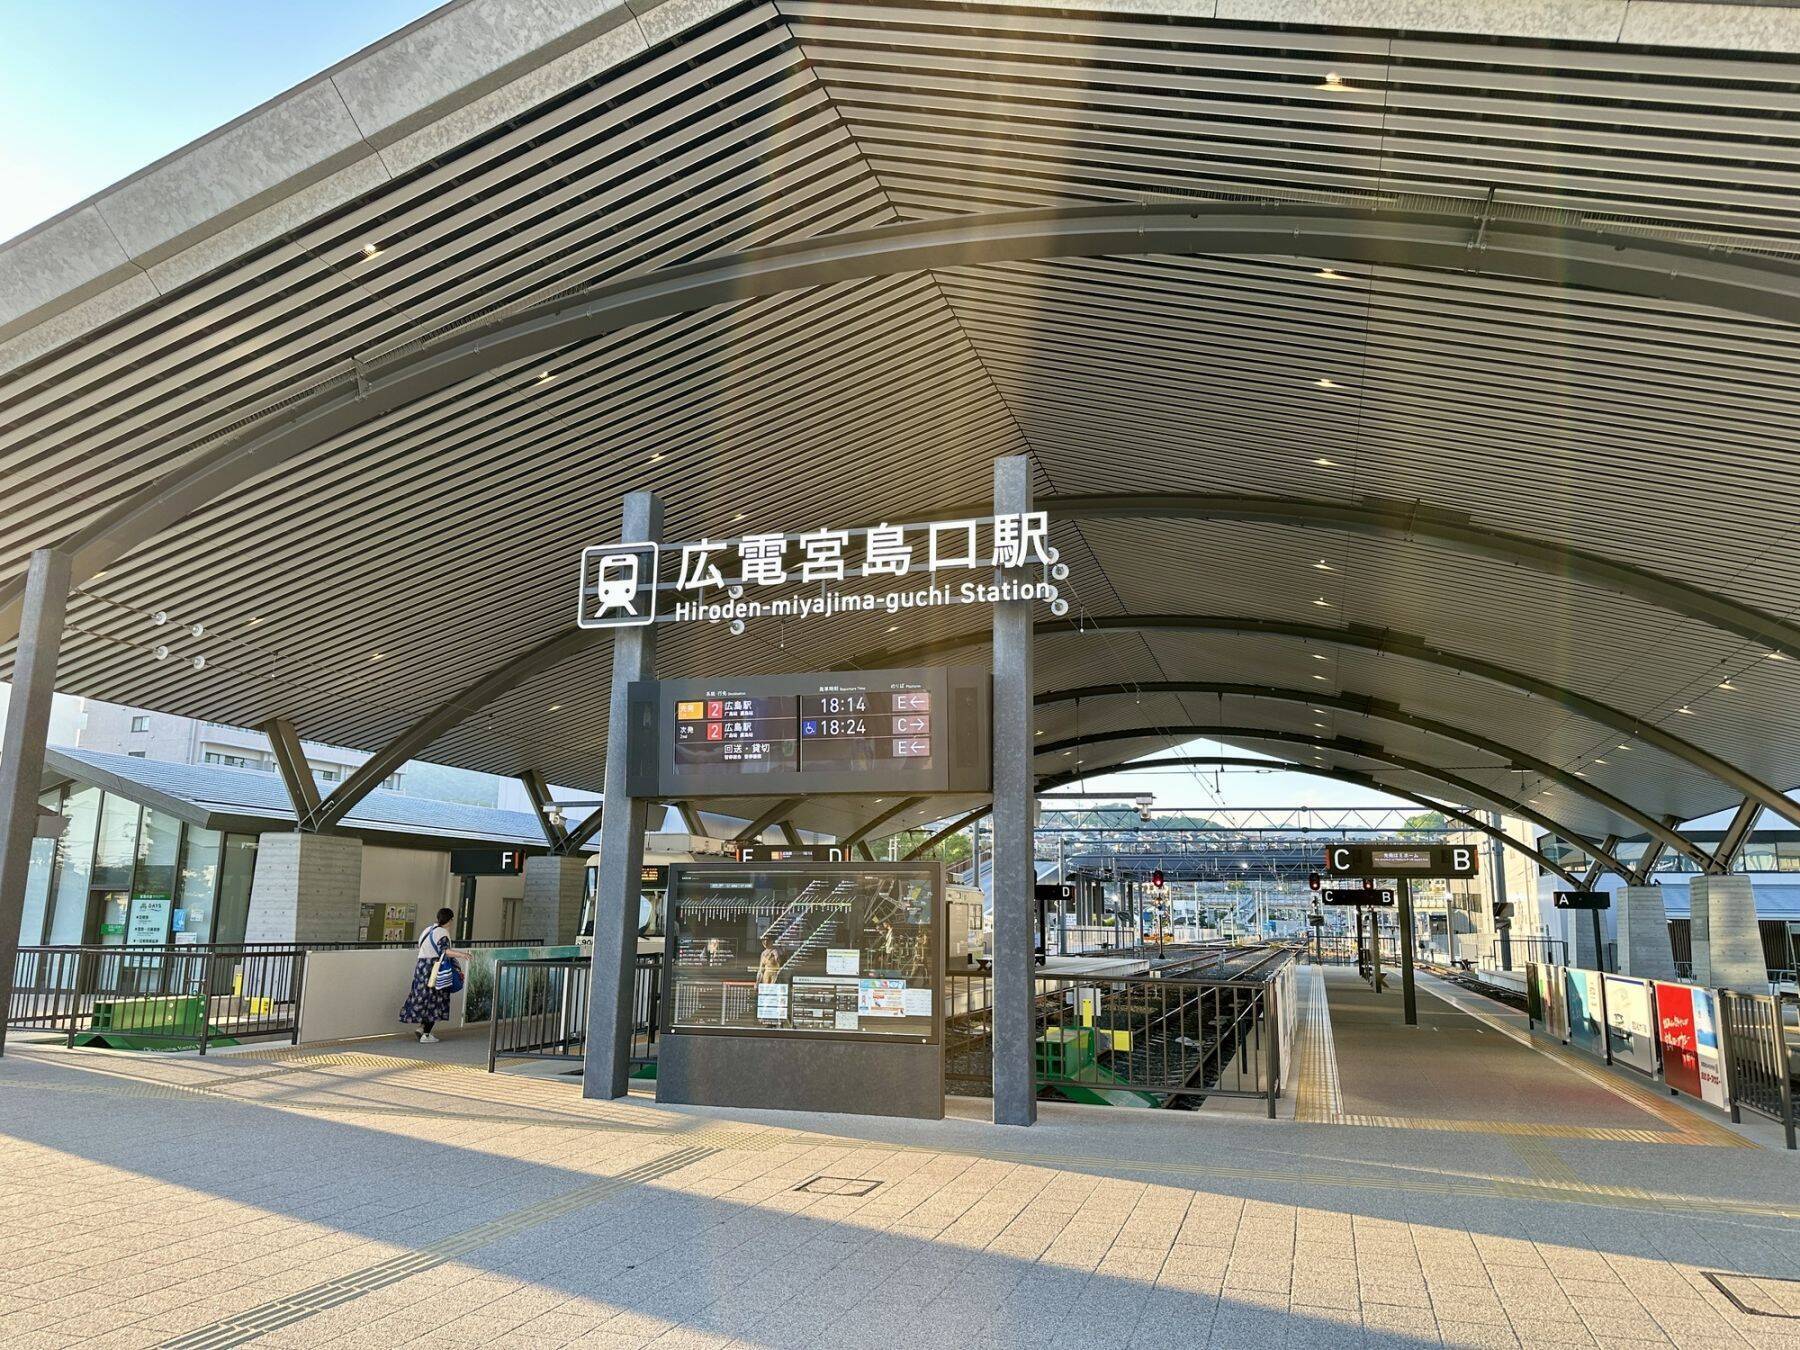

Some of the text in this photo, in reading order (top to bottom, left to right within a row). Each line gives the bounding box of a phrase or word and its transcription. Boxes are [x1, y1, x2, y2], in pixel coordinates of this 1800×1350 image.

[676, 511, 1050, 591] 広電宮島口駅
[675, 579, 1050, 621] Hiroden-miyajima-guchi Station
[711, 703, 719, 717] 2
[724, 701, 752, 711] 広島駅
[821, 697, 866, 713] 18:14
[897, 695, 907, 709] E
[711, 725, 719, 738] 2
[724, 722, 752, 732] 広島駅
[821, 719, 866, 735] 18:24
[897, 718, 907, 732] C
[724, 741, 907, 754] 回送・貸切 E
[502, 852, 513, 869] F
[829, 848, 842, 862] D
[1334, 849, 1470, 871] C B
[1062, 886, 1070, 897] D
[1325, 891, 1391, 902] C B
[1559, 893, 1569, 905] A
